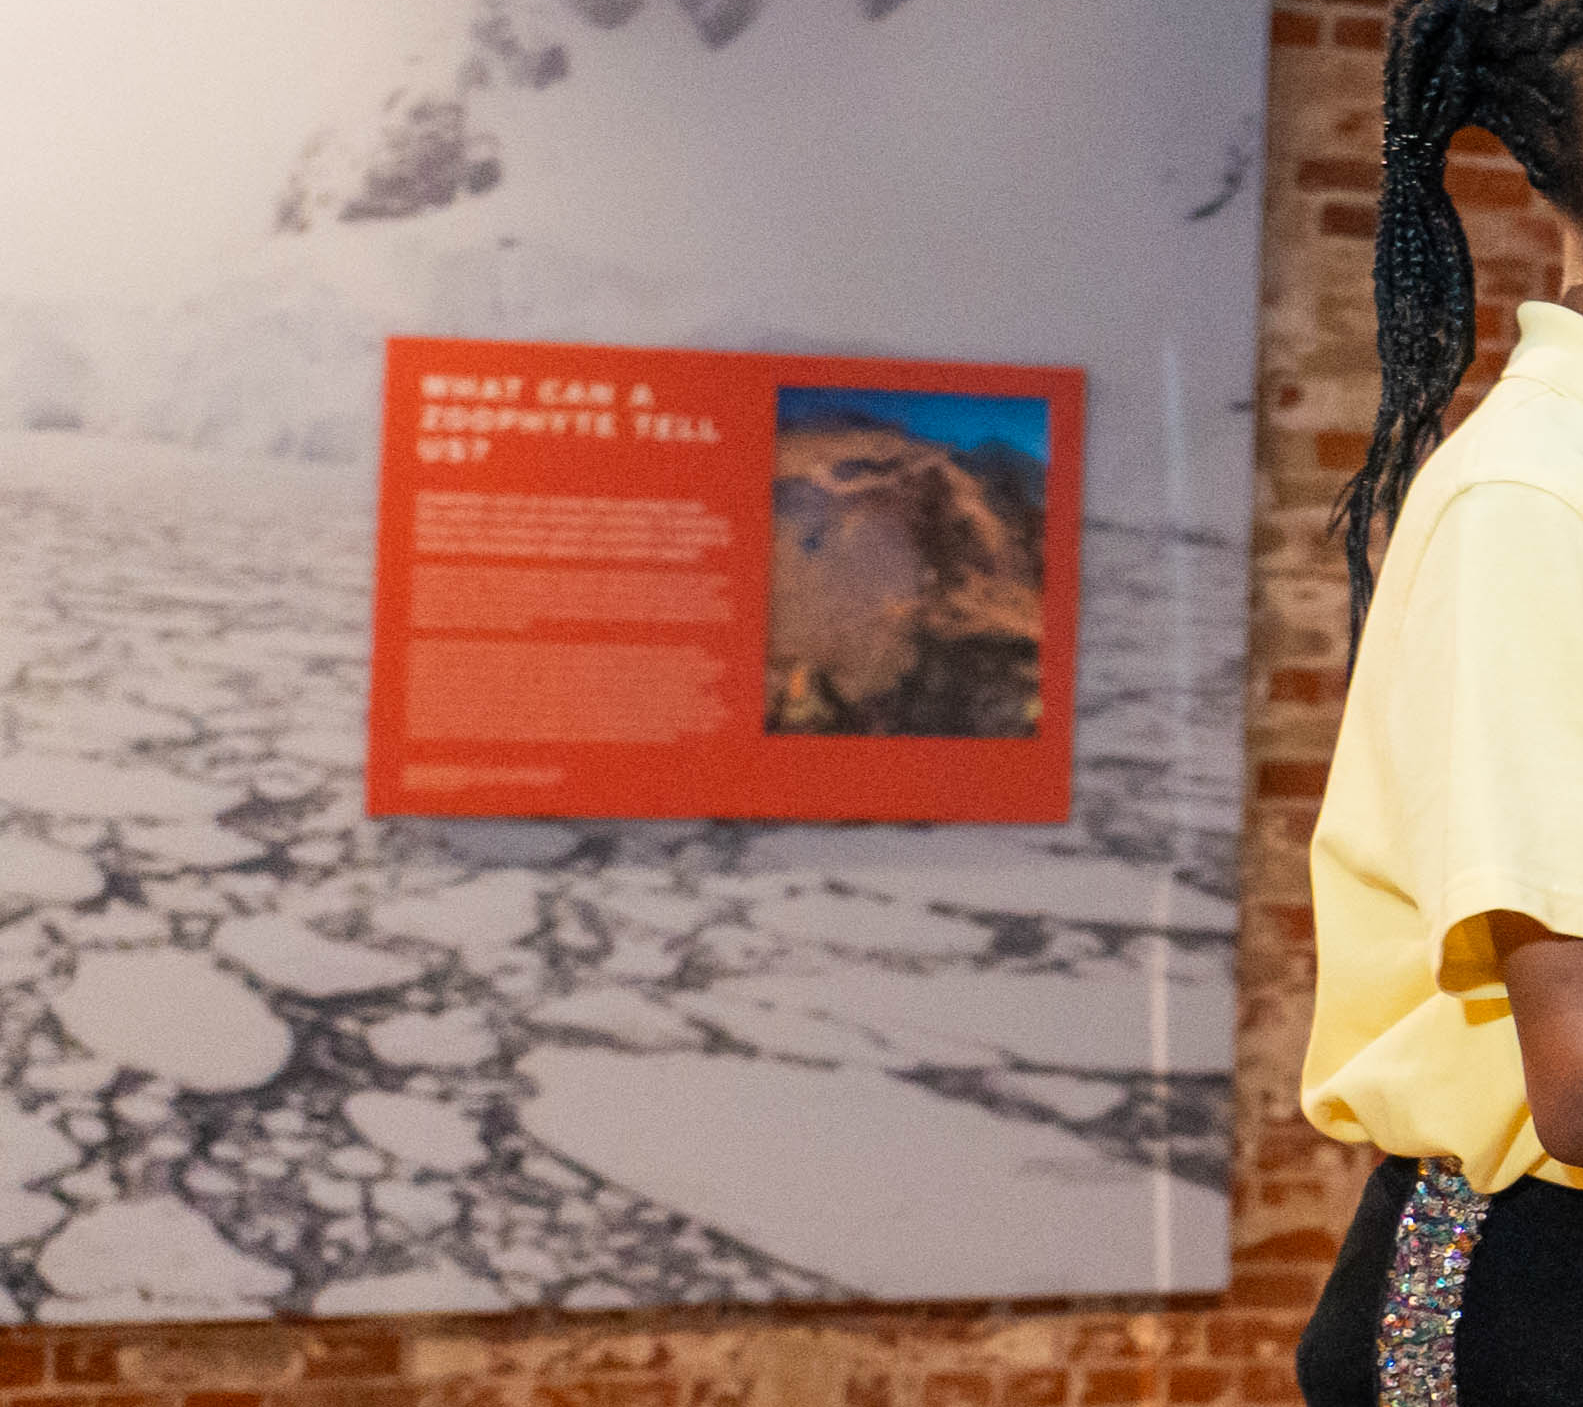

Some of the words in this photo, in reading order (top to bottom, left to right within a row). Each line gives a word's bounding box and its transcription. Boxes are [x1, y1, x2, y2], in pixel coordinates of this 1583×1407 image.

[421, 375, 523, 399] WHAT
[537, 378, 615, 405] CAN
[629, 382, 654, 408] A
[420, 404, 616, 438] ZOOPHYTE
[634, 413, 720, 444] TELL
